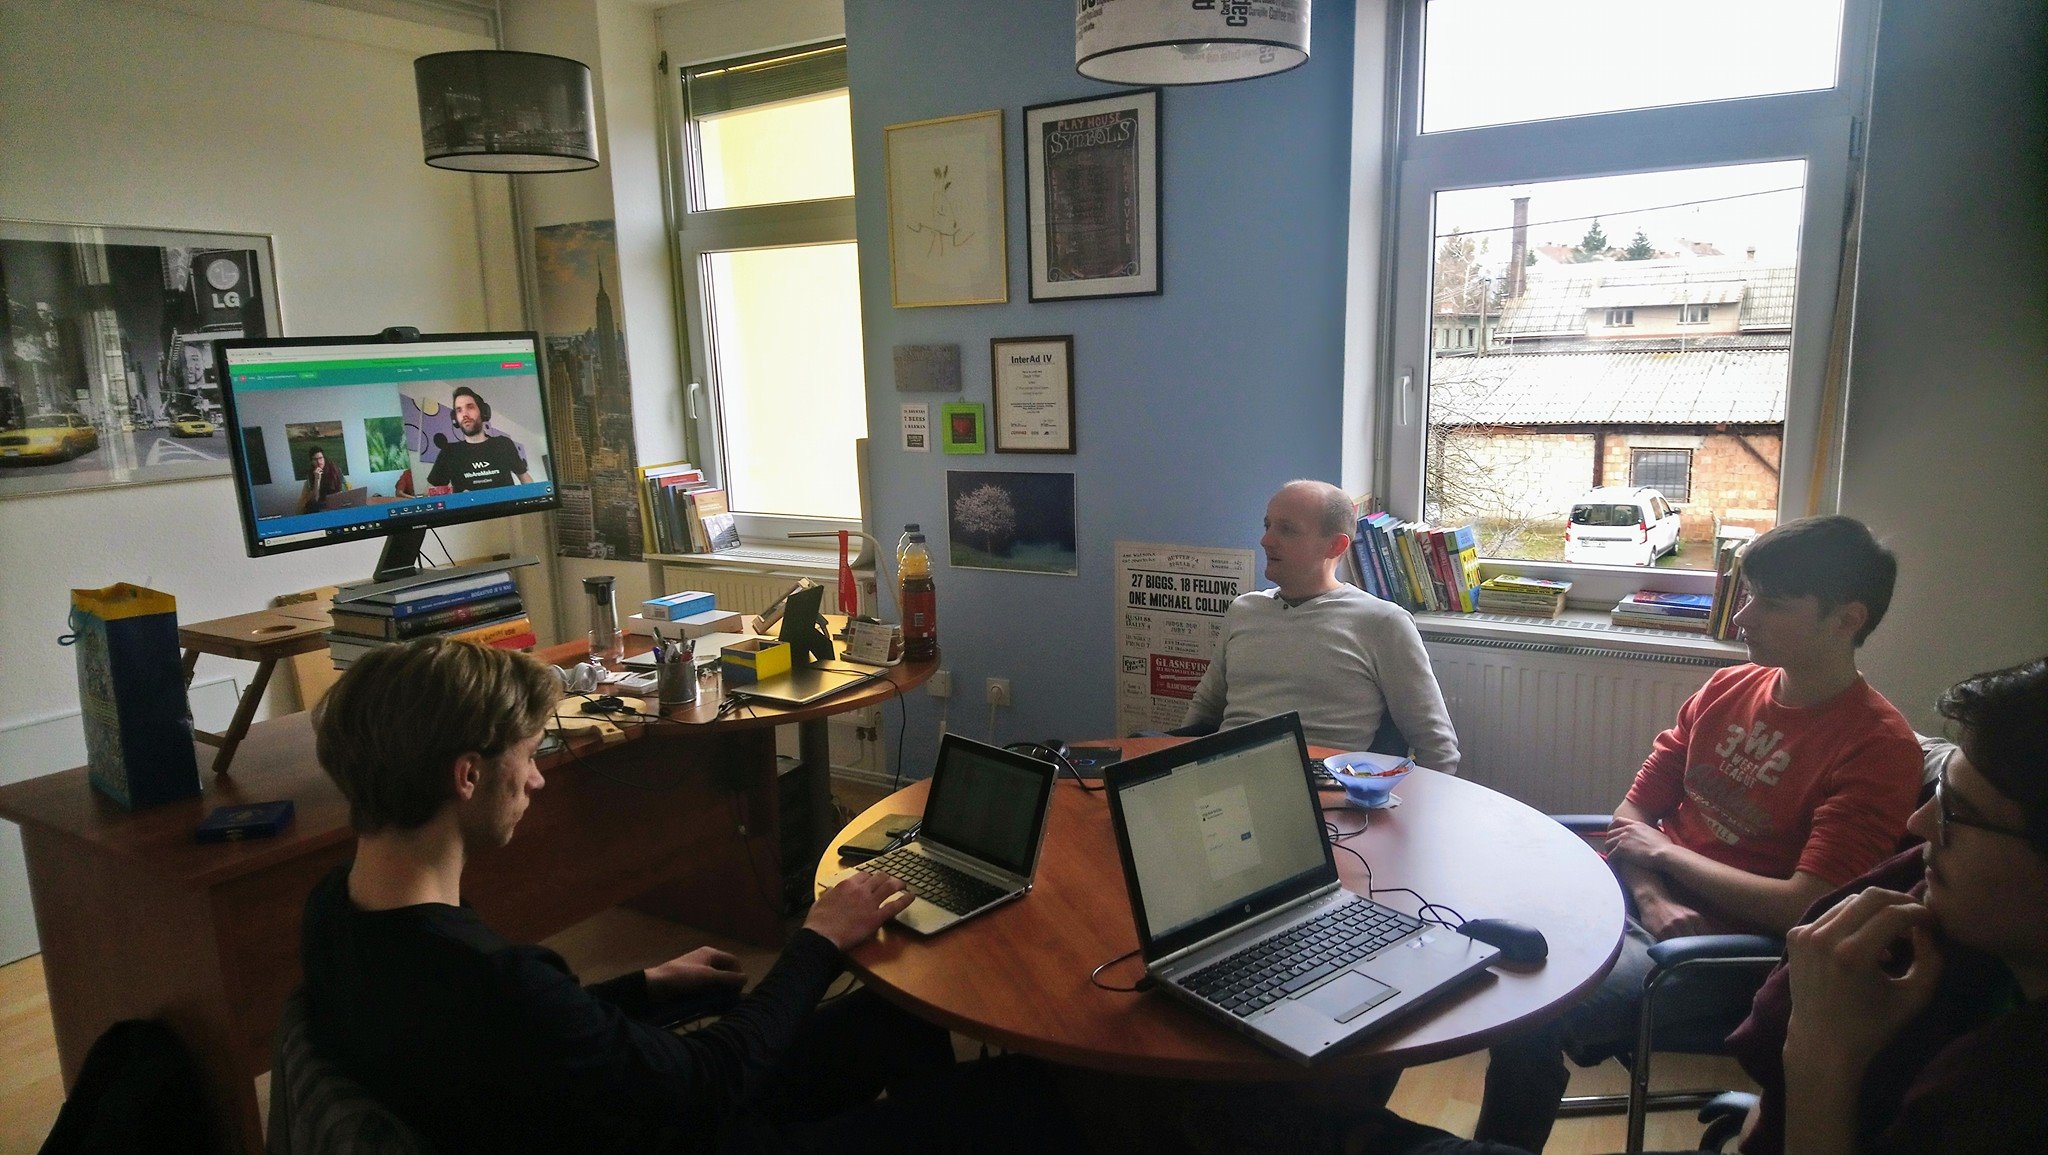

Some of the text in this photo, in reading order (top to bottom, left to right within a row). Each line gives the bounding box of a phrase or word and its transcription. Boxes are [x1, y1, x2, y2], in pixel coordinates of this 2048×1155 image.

[1058, 112, 1121, 131] PLAY HOUSE
[1050, 121, 1131, 155] SYMBOLS
[212, 291, 240, 309] LG
[1011, 354, 1052, 364] InterAd IV
[463, 468, 500, 479] WeAreMakers
[1131, 573, 1241, 596] 27 BIGGS. 18 FELLOWS.
[1129, 591, 1146, 606] ONE
[1149, 593, 1192, 610] MICHAEL
[1155, 658, 1208, 671] GLASNEVIN
[1719, 760, 1757, 788] LEAGUE
[1732, 753, 1758, 776] WEST
